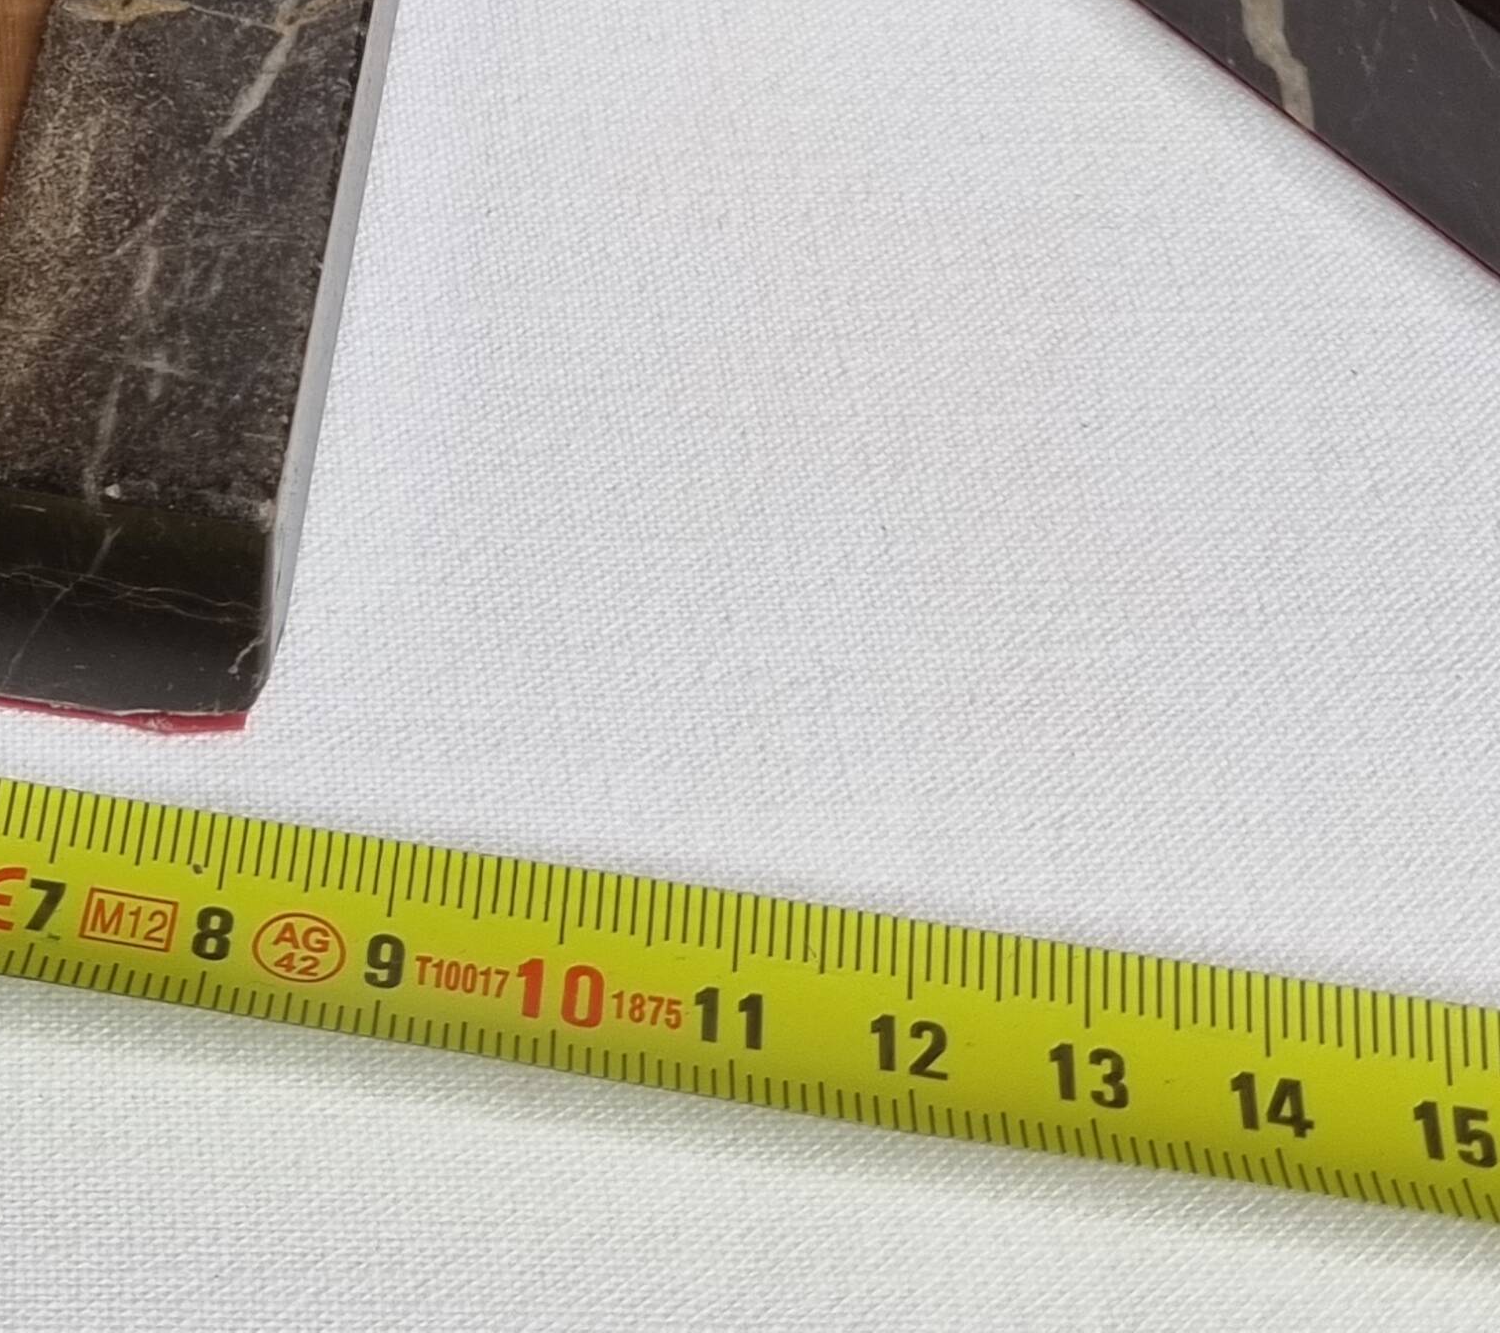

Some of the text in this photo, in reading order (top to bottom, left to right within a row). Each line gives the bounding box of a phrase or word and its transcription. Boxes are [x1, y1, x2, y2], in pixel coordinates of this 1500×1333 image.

[24, 878, 67, 933] 7
[90, 897, 169, 943] M12
[191, 906, 234, 962] 8
[272, 921, 331, 955] AG
[364, 933, 406, 989] 9
[414, 955, 510, 999] T10017
[516, 957, 604, 1028] 10
[611, 990, 683, 1030] 1875
[694, 986, 764, 1050] 11
[870, 1014, 949, 1081] 12
[1049, 1042, 1129, 1110] 13
[1230, 1071, 1314, 1138] 14
[1413, 1101, 1498, 1169] 15
[274, 951, 320, 977] 42
